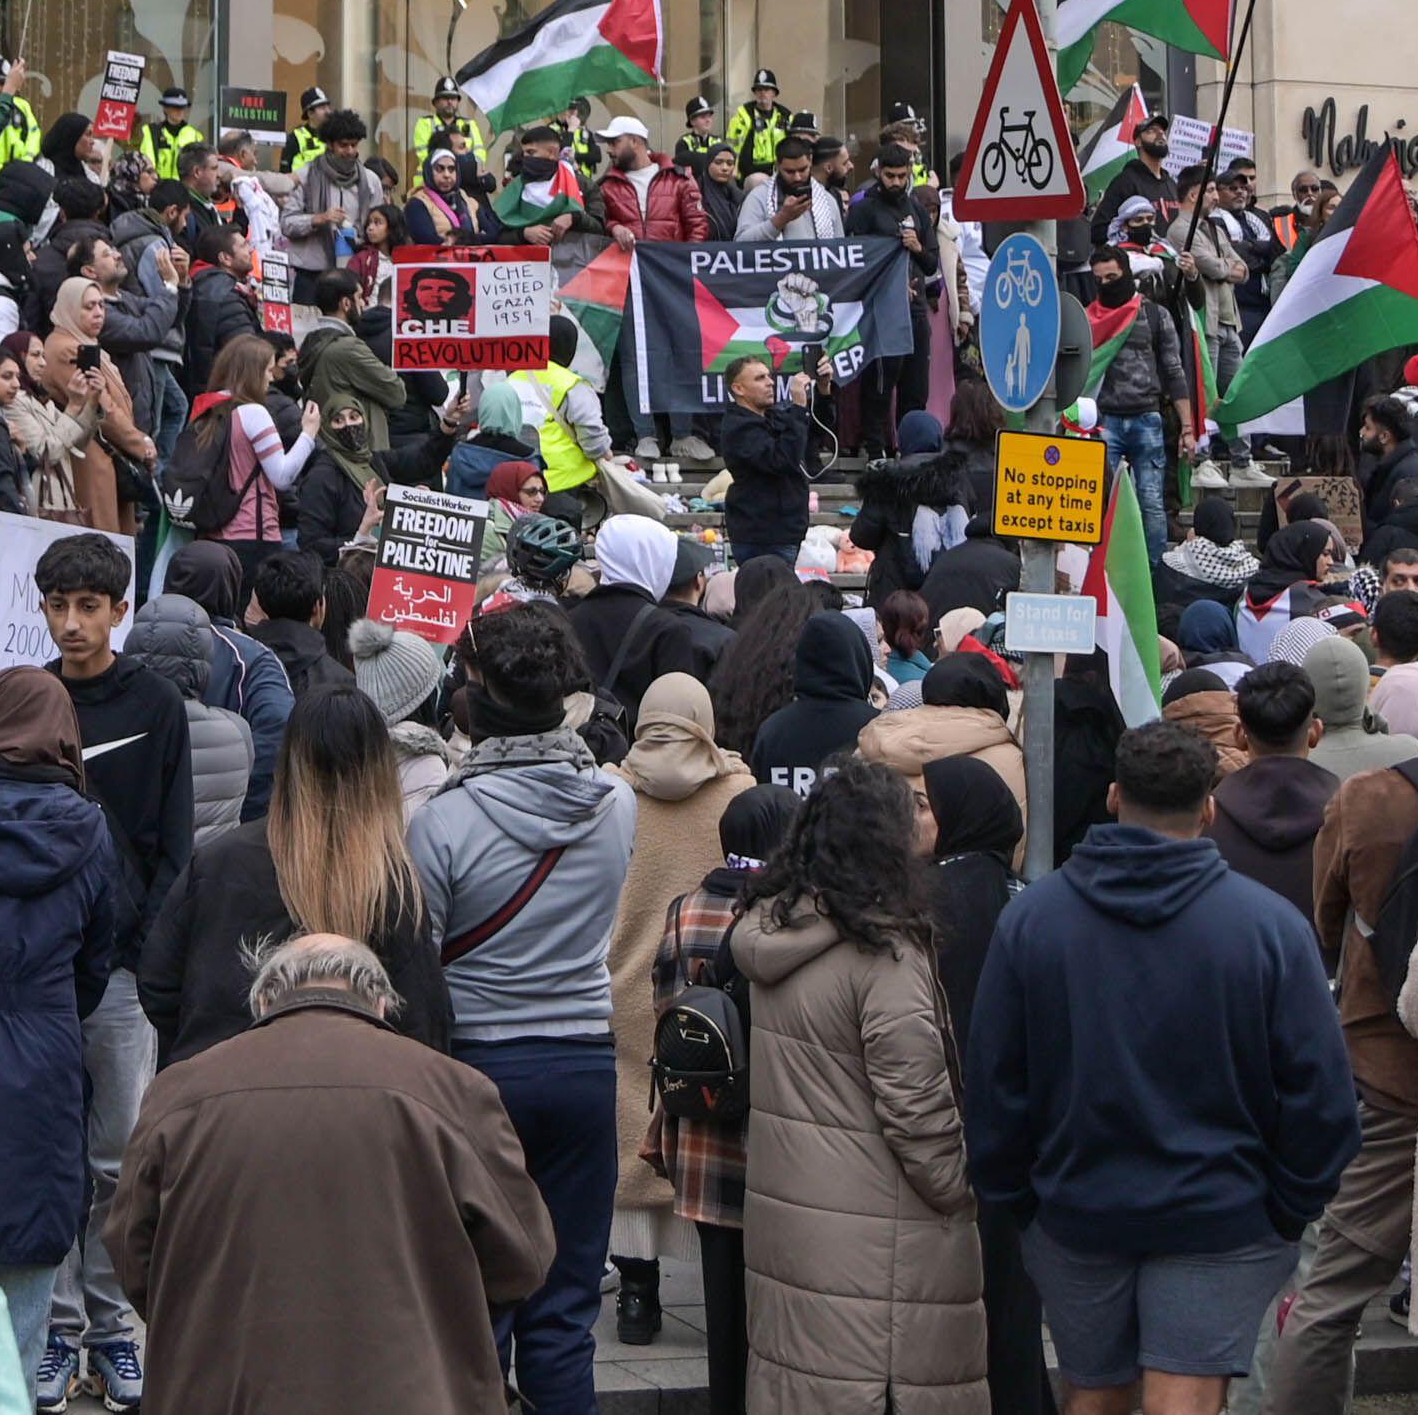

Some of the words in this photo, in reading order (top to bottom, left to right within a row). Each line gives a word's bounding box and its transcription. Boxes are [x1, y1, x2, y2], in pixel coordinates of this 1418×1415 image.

[229, 106, 279, 122] PALESTINE
[690, 244, 866, 275] PALESTINE
[493, 264, 534, 281] CHE
[482, 281, 544, 296] VISITED
[492, 296, 534, 310] GAZA
[401, 319, 469, 335] CHE
[494, 310, 532, 326] 1959
[1004, 467, 1026, 484] No
[1032, 470, 1097, 493] stopping
[402, 489, 443, 507] Socialist
[441, 496, 472, 513] Worker
[1006, 491, 1022, 503] at
[1027, 493, 1053, 511] any
[1060, 494, 1092, 510] time
[391, 506, 474, 543] FREEDOM
[1001, 514, 1053, 531] except
[1058, 516, 1095, 534] taxis
[424, 535, 439, 548] for
[382, 540, 475, 580] PALESTINE
[392, 576, 452, 603] الحرية
[381, 601, 458, 628] لفلسطين
[1015, 601, 1060, 621] Stand
[1067, 605, 1089, 621] for
[1041, 628, 1079, 643] taxis
